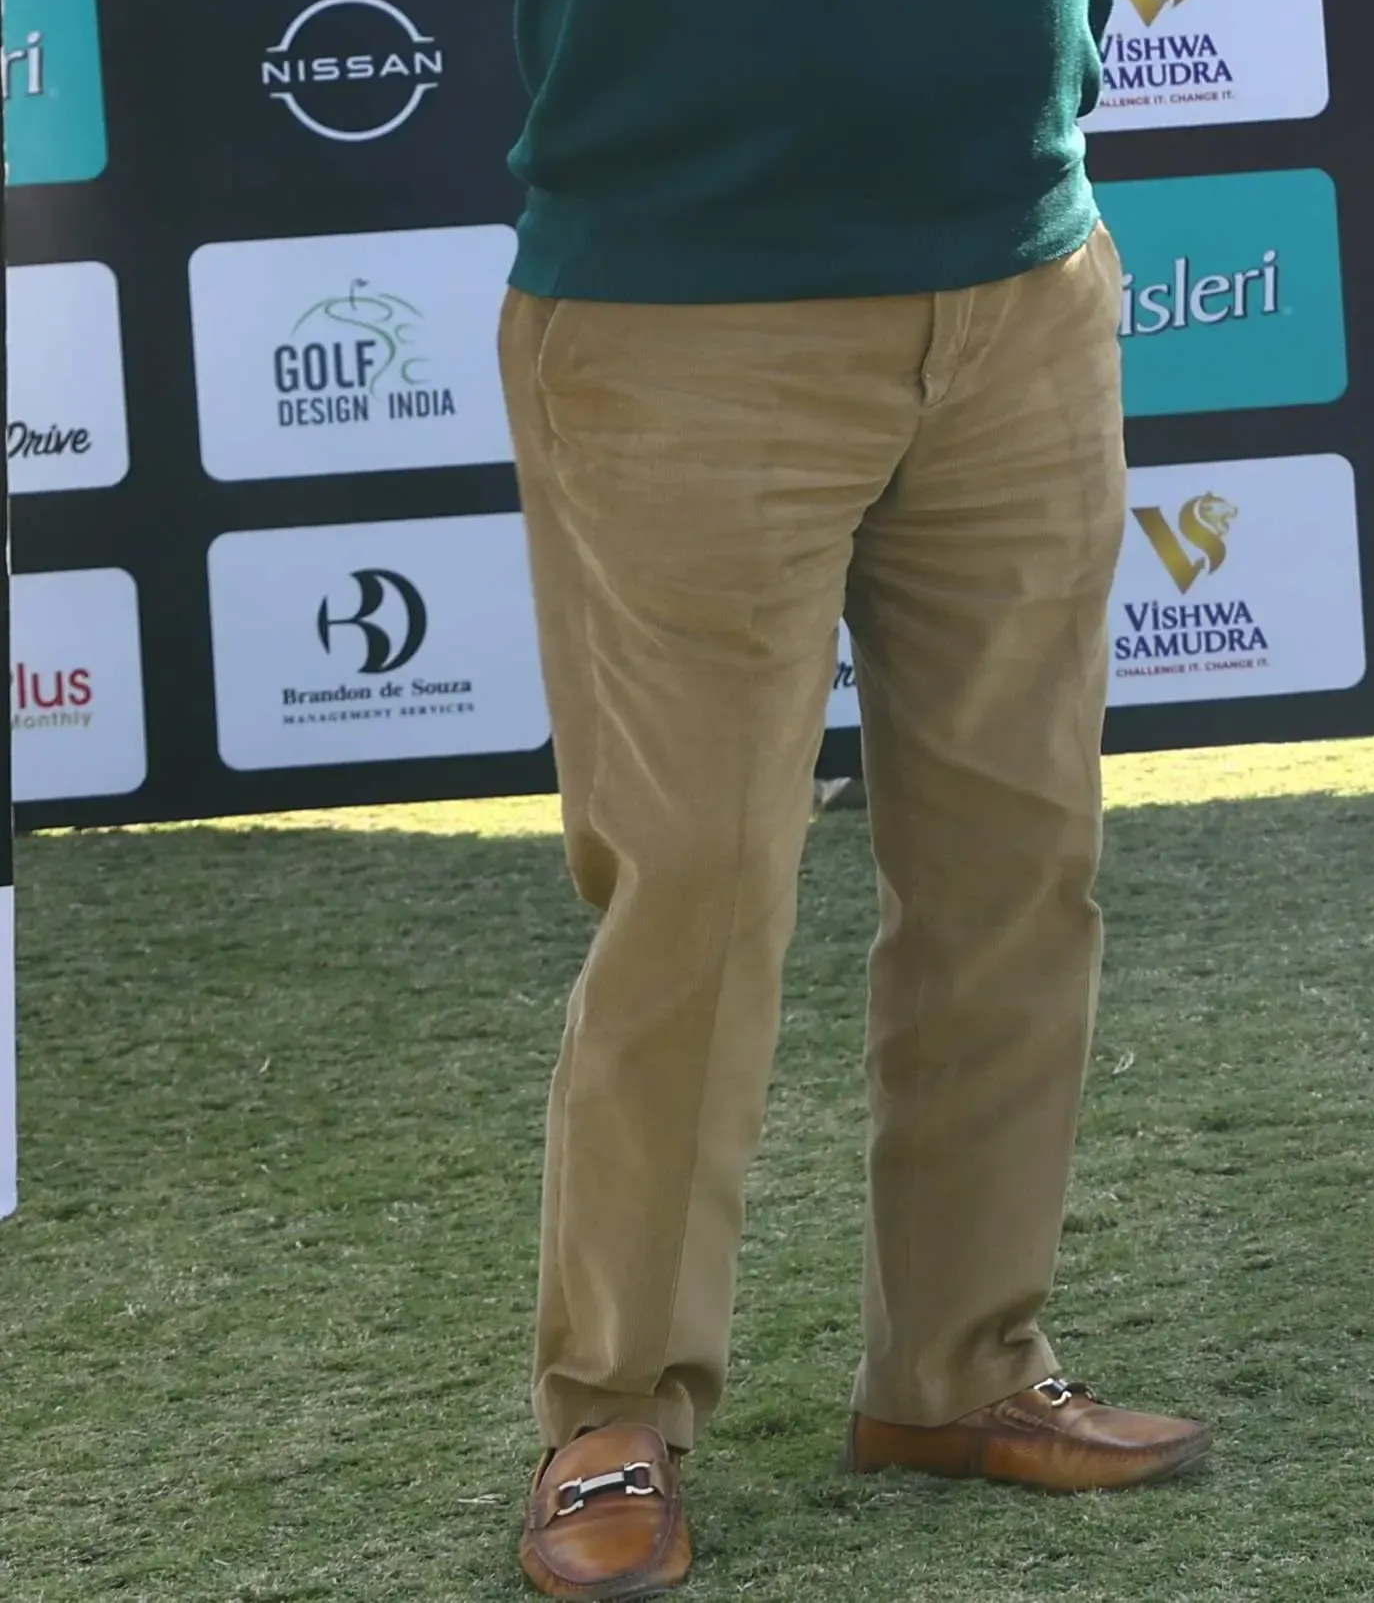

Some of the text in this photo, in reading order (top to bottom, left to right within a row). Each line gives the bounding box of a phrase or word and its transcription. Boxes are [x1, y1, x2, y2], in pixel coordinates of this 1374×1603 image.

[261, 50, 443, 84] NISSAN
[1102, 59, 1233, 90] AMUDRA
[1119, 249, 1278, 337] isleri
[274, 339, 376, 393] GOLF
[278, 388, 456, 427] DESIGN INDIA
[1123, 599, 1254, 633] VISHWA
[1114, 625, 1268, 661] SAMUDRA
[1115, 664, 1185, 678] CHALLENGE
[1205, 659, 1254, 672] CHANGE
[282, 678, 472, 706] Brandon de Souza
[283, 702, 476, 725] MANAGEMENT SERVICES
